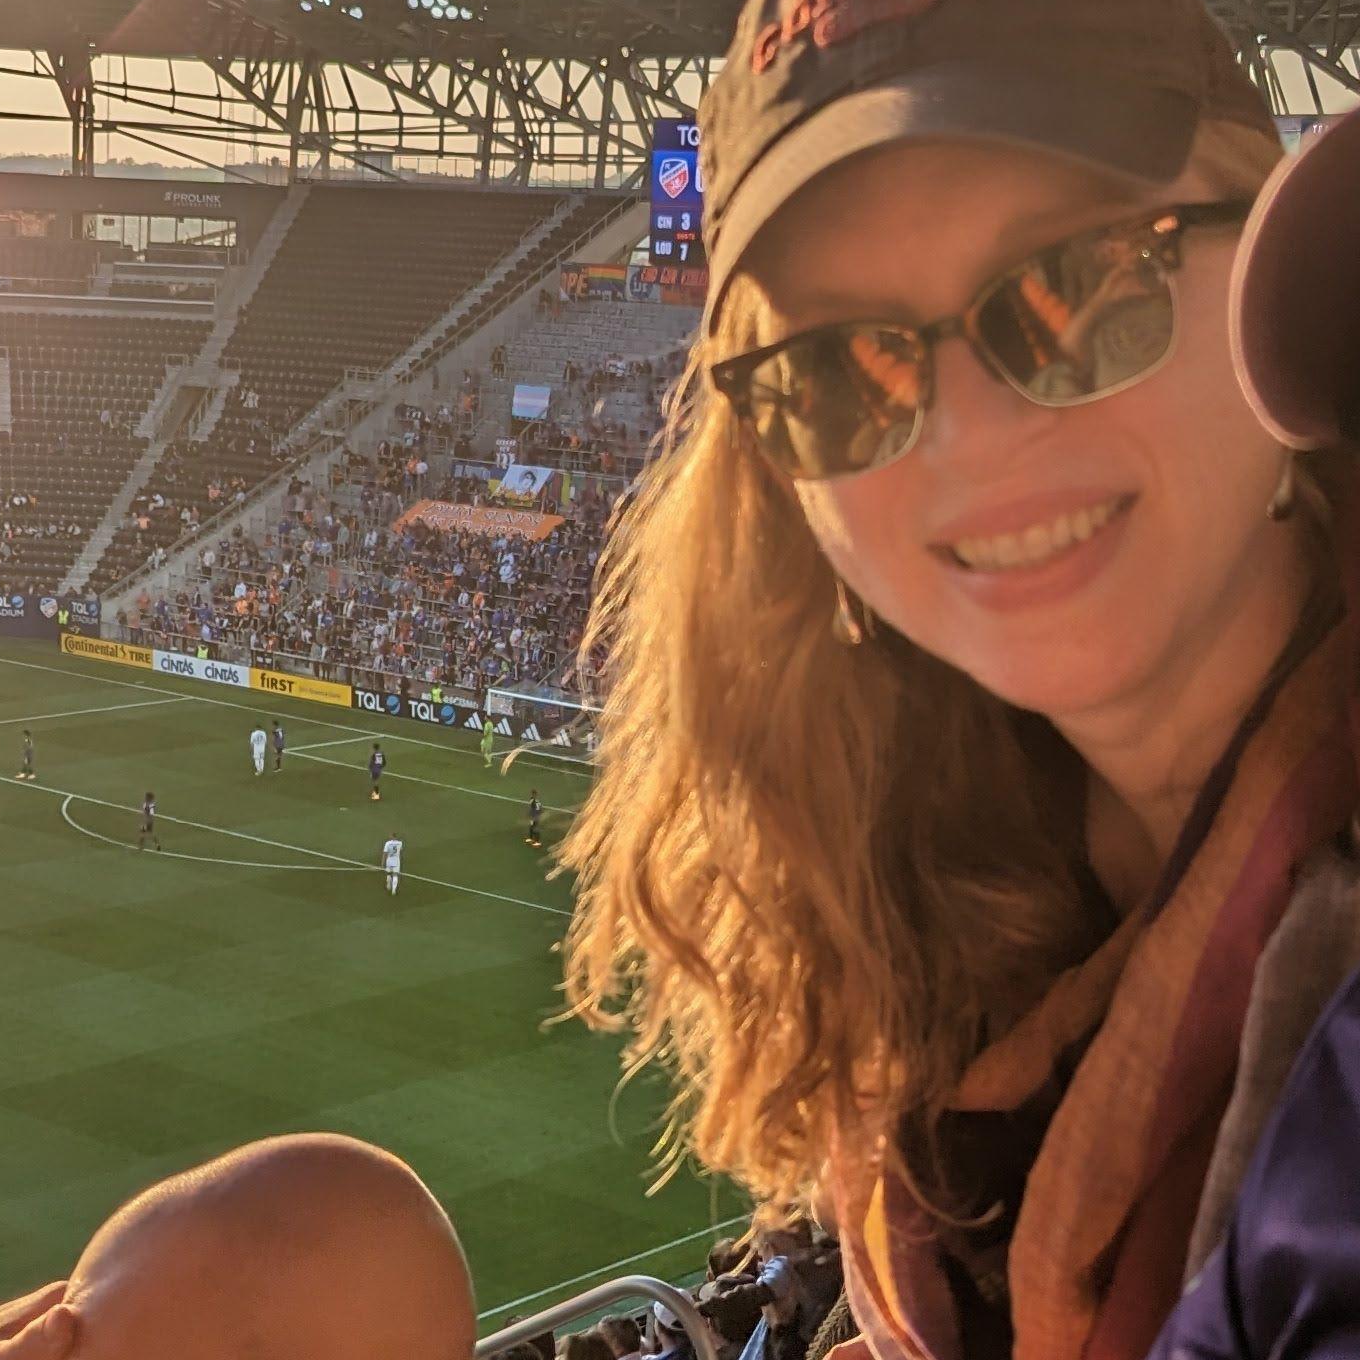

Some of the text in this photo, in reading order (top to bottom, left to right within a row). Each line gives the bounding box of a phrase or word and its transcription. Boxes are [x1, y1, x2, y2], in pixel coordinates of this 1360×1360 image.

[681, 213, 691, 230] 3
[655, 242, 672, 255] LOU
[71, 601, 88, 615] TQL
[64, 635, 151, 664] Continental TIRE
[355, 691, 385, 712] TQL
[408, 700, 439, 722] TQL
